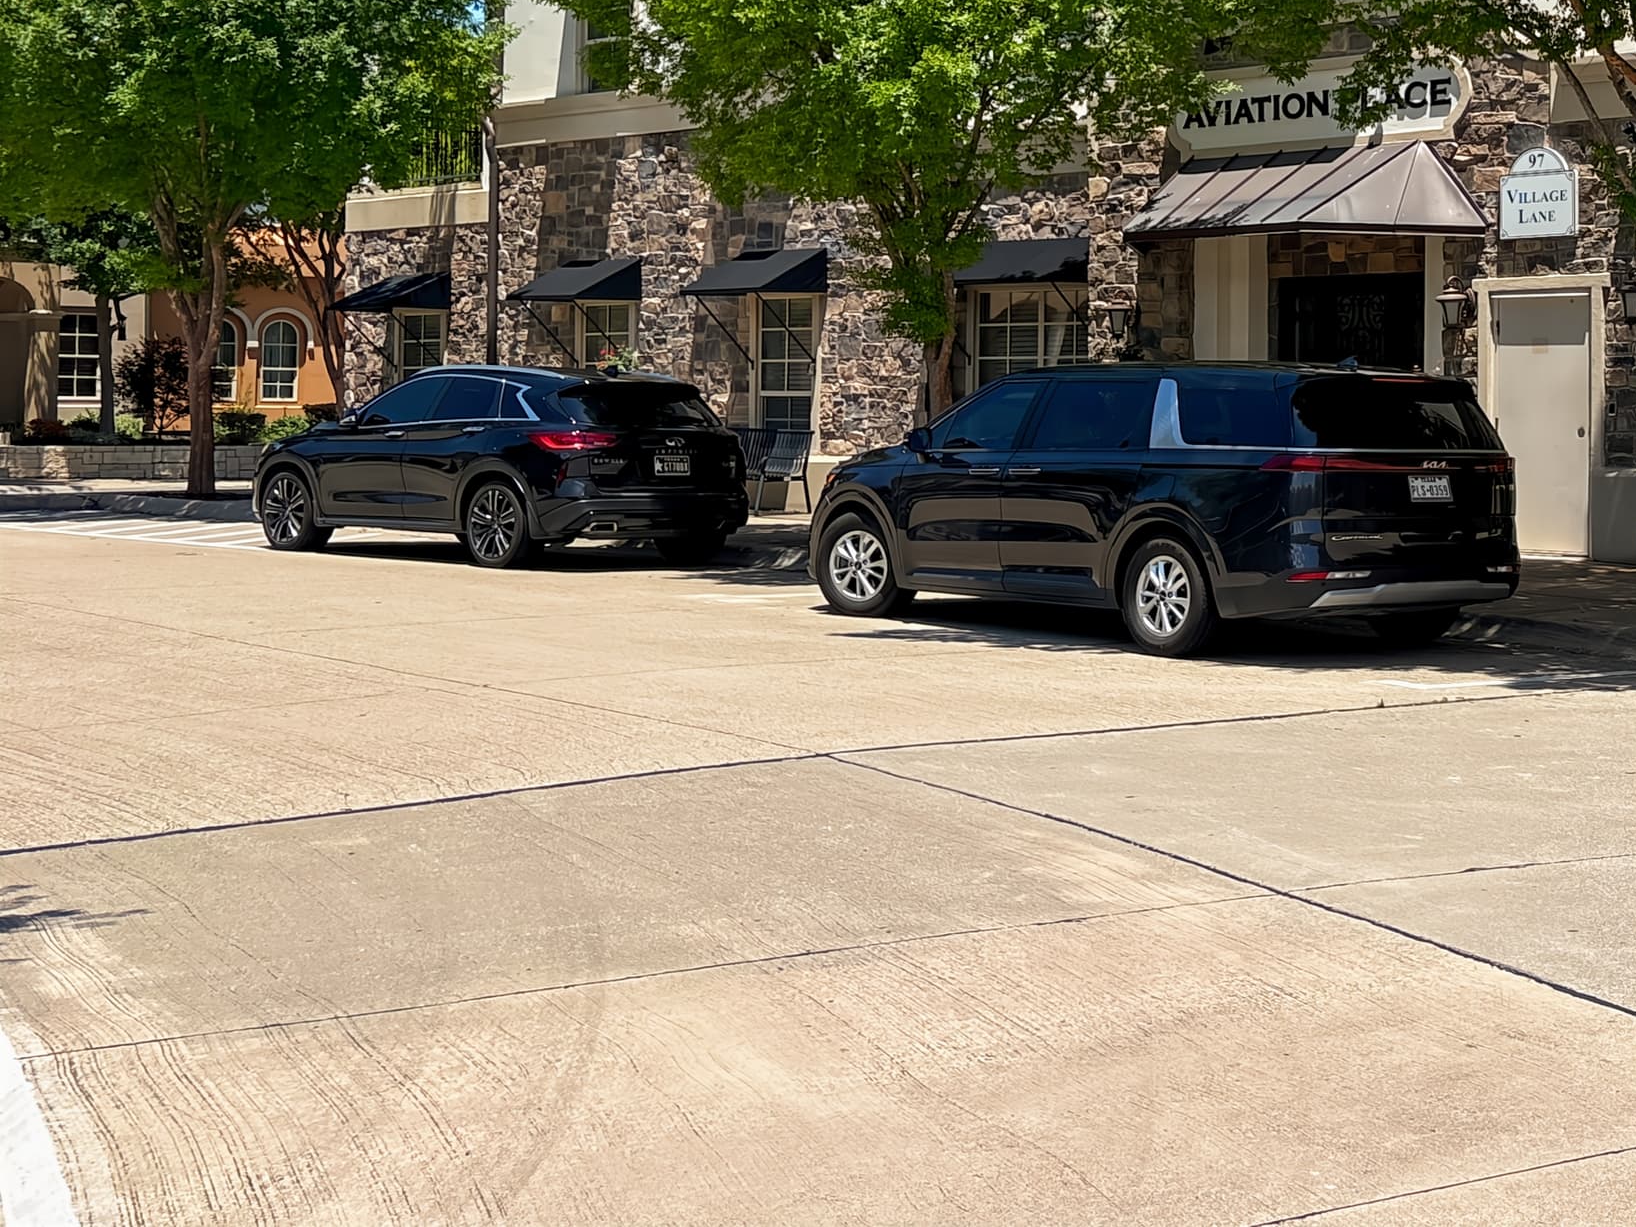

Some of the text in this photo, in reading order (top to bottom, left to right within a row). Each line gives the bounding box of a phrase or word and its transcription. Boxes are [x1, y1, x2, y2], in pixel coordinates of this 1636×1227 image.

[1182, 76, 1453, 130] AVIATION LACE
[1528, 153, 1545, 169] 97
[1506, 188, 1569, 205] VILLAGE
[1518, 208, 1557, 225] LANE
